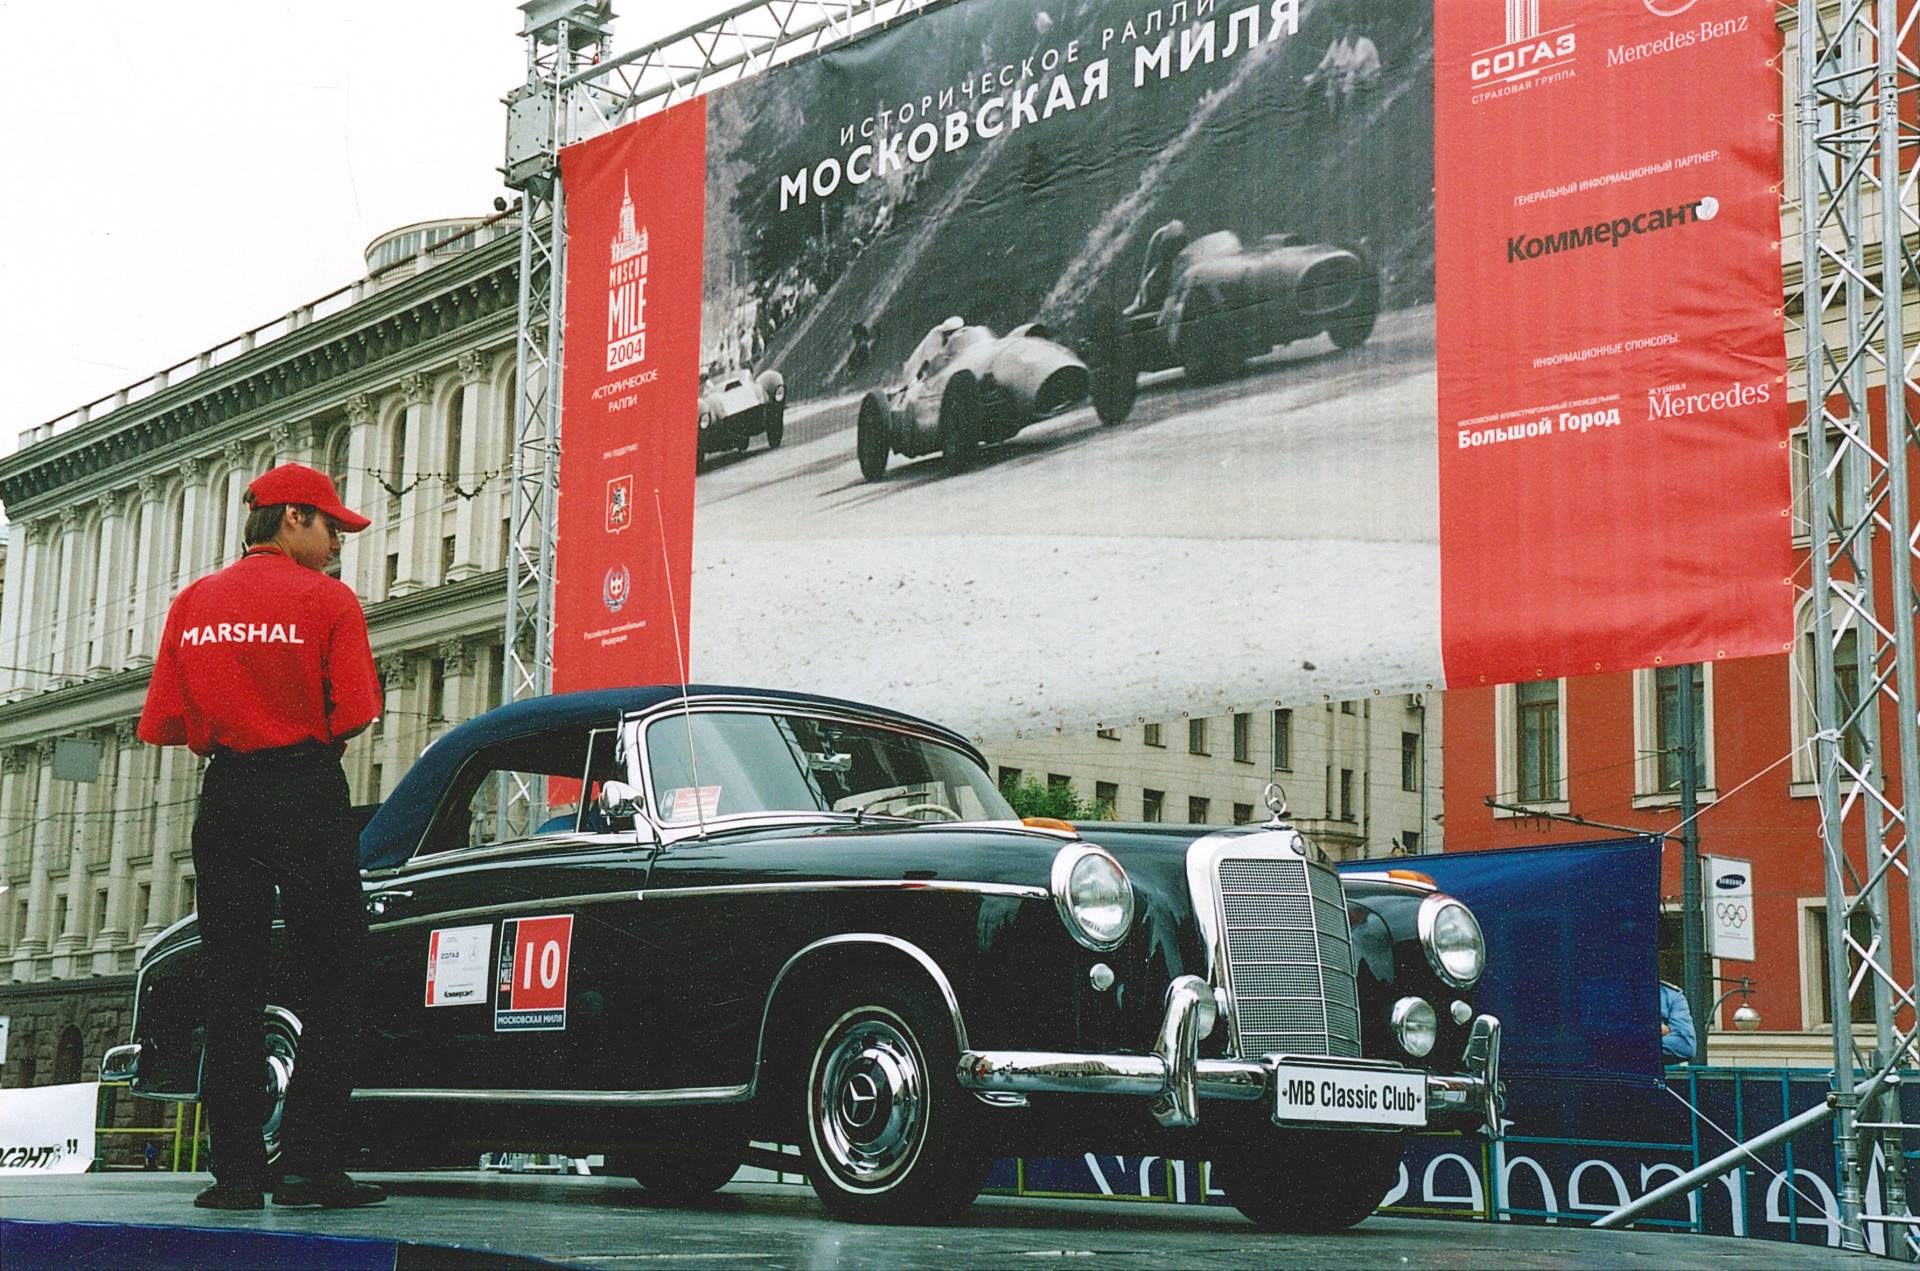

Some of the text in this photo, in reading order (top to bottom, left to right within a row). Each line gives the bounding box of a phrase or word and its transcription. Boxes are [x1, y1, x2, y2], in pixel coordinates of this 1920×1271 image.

[1471, 33, 1576, 81] СОГАЗ
[1606, 15, 1748, 67] Mercedes-Benz
[840, 0, 1216, 147] ИСТОРИЧЕСКОЕ РАЛЛИ
[1471, 68, 1576, 104] СТРАХОВАЯ ГРУППА
[779, 0, 1300, 212] МОСКОВСКАЯ МИЛЯ
[1514, 183, 1577, 206] ГЕНЕРАЛЬНЫЙ
[1579, 160, 1672, 191] ИНФОРМАЦИОННЫЙ
[609, 254, 648, 288] MOSCOW
[608, 277, 647, 342] MILE
[609, 338, 642, 366] 2004
[1533, 343, 1622, 368] ИНФОРМАЦИОННЫЕ
[591, 369, 658, 400] ИСТОРИЧЕСКОЕ
[608, 394, 637, 413] РАЛЛИ
[1647, 382, 1769, 421] Mercedes
[1458, 408, 1621, 449] Большой Город
[180, 622, 305, 647] MARSHAL
[523, 940, 560, 989] 10
[1288, 1079, 1415, 1111] MB Classic Club
